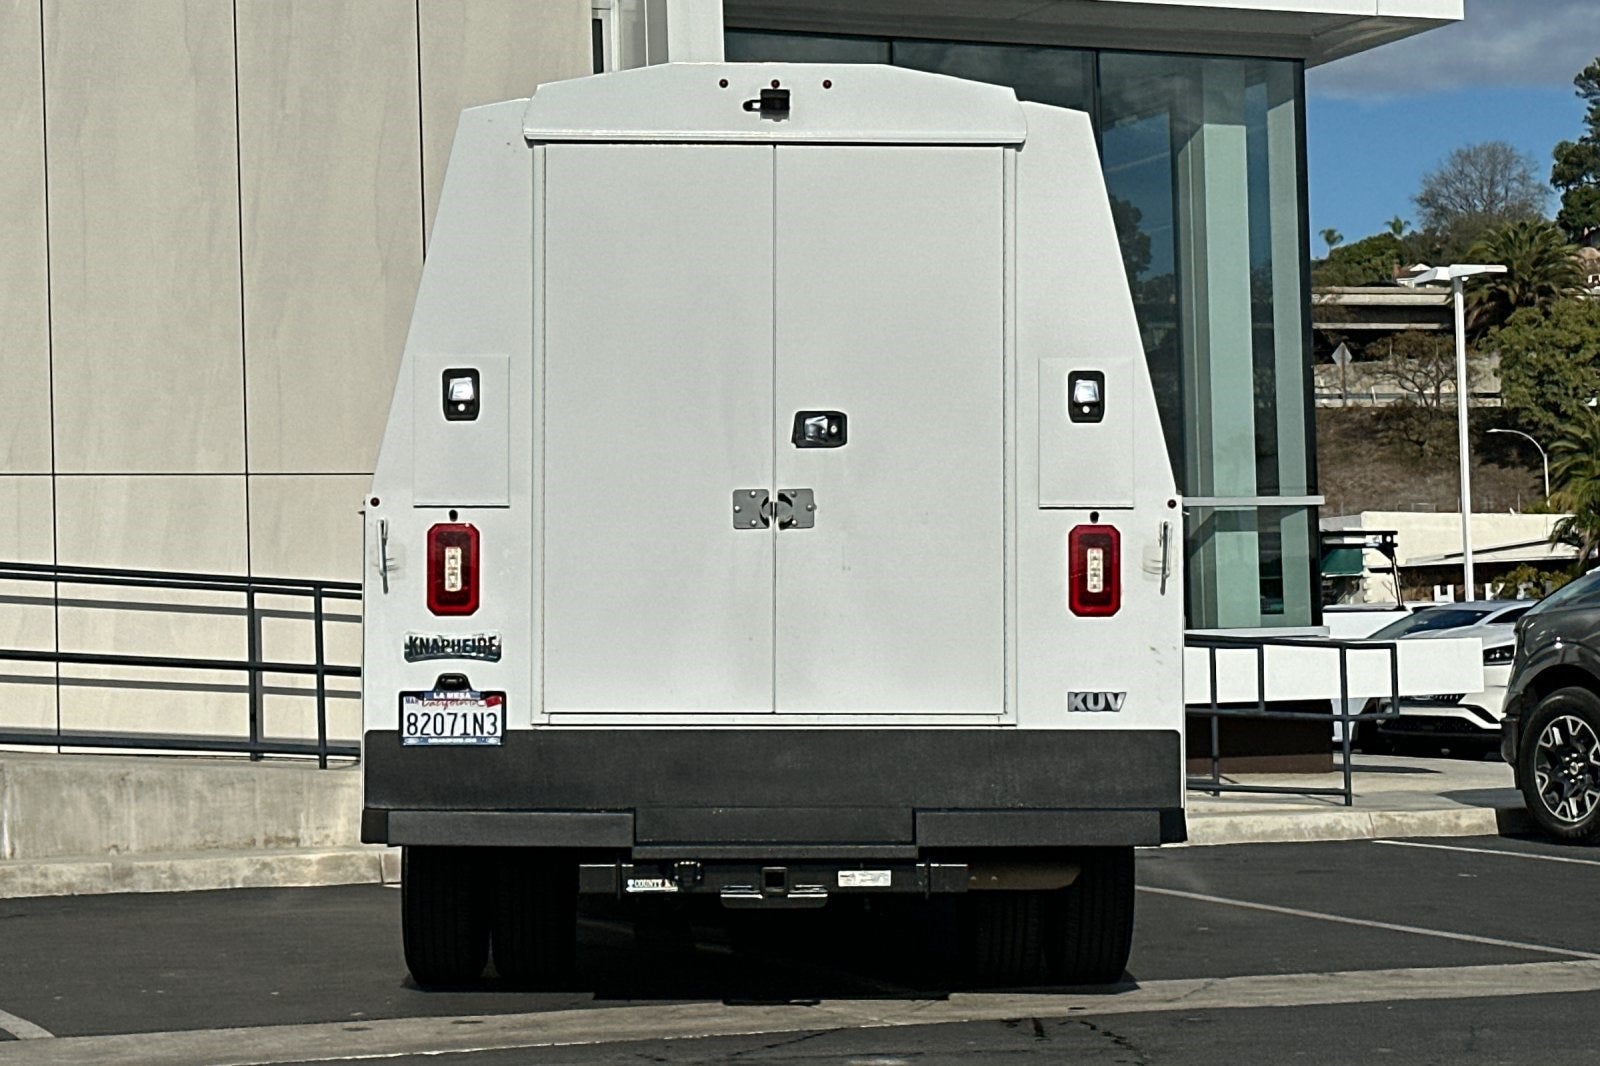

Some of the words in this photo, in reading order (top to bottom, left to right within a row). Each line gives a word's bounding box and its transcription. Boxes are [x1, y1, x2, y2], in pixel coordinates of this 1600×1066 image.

[405, 634, 499, 658] KNAPHEIDE
[1068, 692, 1127, 712] KUV
[406, 712, 498, 736] 82071N3
